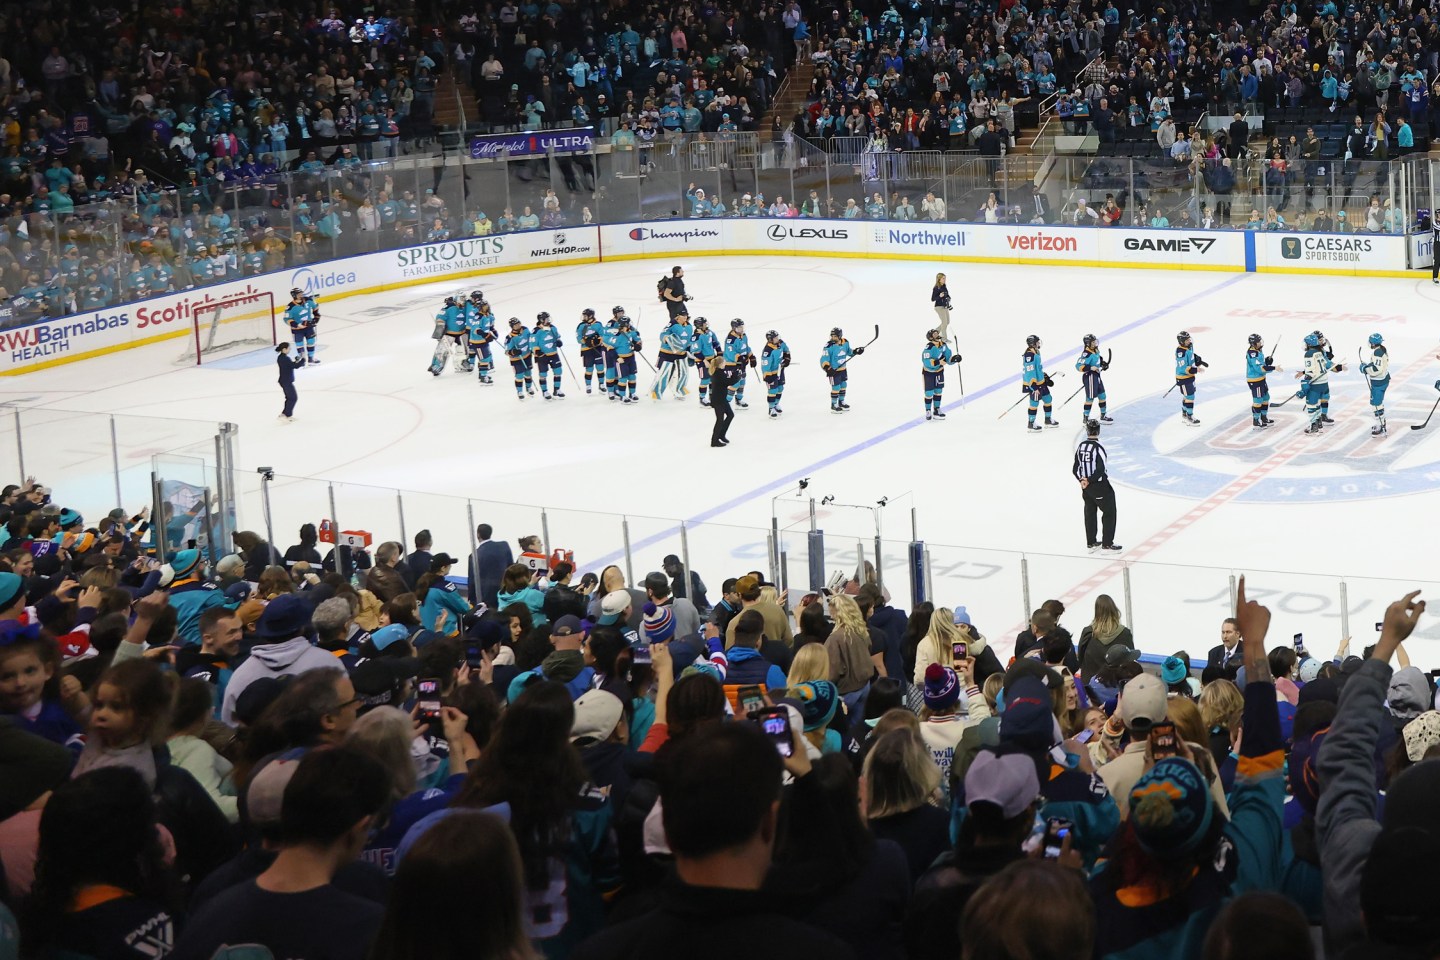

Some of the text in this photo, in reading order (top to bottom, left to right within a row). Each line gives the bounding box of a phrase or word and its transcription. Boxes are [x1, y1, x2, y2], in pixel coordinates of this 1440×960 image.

[472, 135, 592, 156] Michelob ULTRA
[629, 227, 719, 242] Champion
[789, 228, 849, 240] LEXUS
[888, 229, 966, 247] Northwell
[1006, 232, 1077, 252] verizon
[397, 236, 505, 268] SPROUTS
[530, 245, 591, 258] NHLSHOP.COM
[1304, 237, 1373, 253] CAESARS
[1305, 251, 1361, 262] SPORTSBOOK
[402, 254, 500, 278] FARMERS MARKET
[304, 268, 357, 294] Midea
[136, 285, 260, 330] Scotiabank
[12, 339, 70, 363] HEALTH
[1080, 451, 1091, 462] 72
[1275, 479, 1392, 497] YORK
